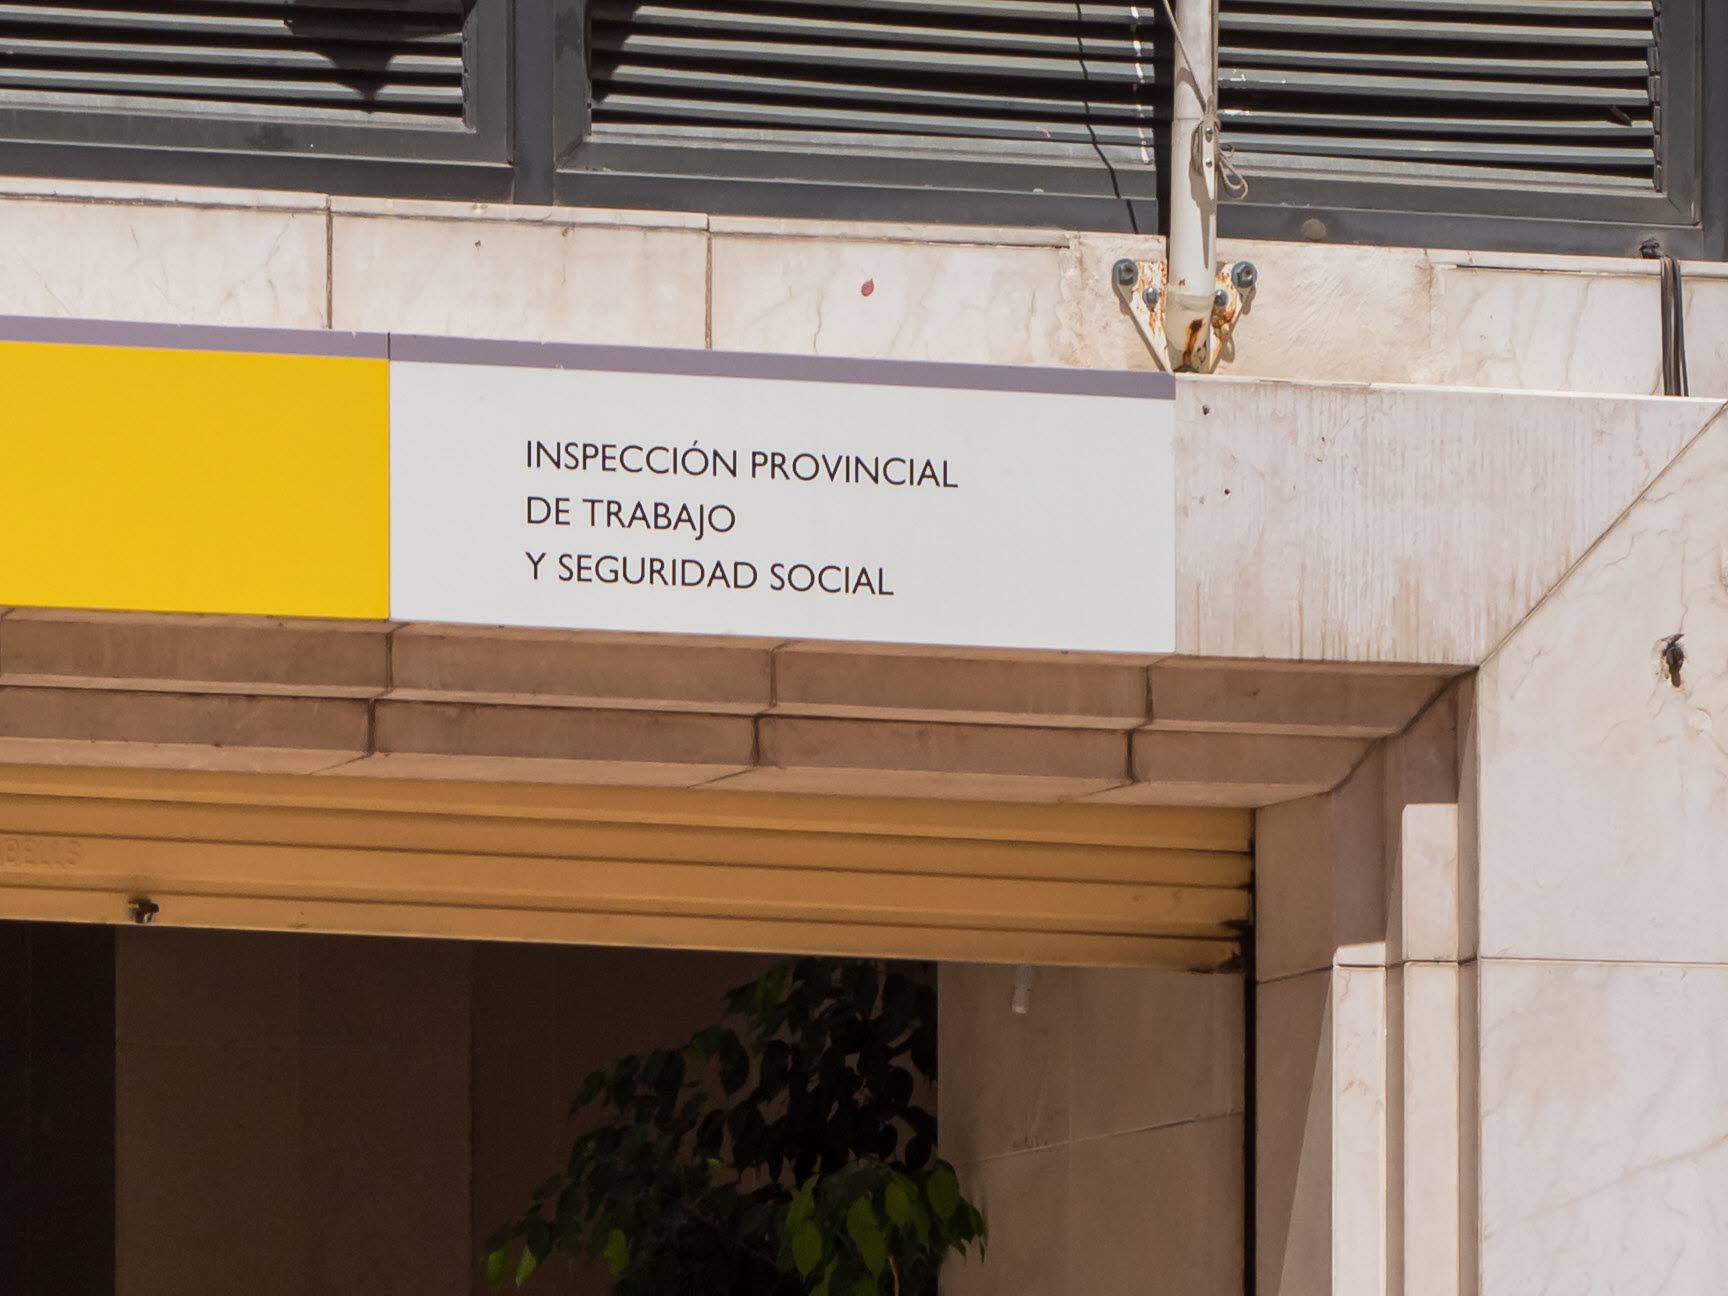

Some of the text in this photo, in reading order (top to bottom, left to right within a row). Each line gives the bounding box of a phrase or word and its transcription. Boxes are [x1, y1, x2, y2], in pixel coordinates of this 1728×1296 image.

[527, 440, 959, 488] INSPECCIÓN PROVINCIAL
[527, 496, 736, 541] DE TRABAJO
[525, 551, 894, 596] Y SEGURIDAD SOCIAL
